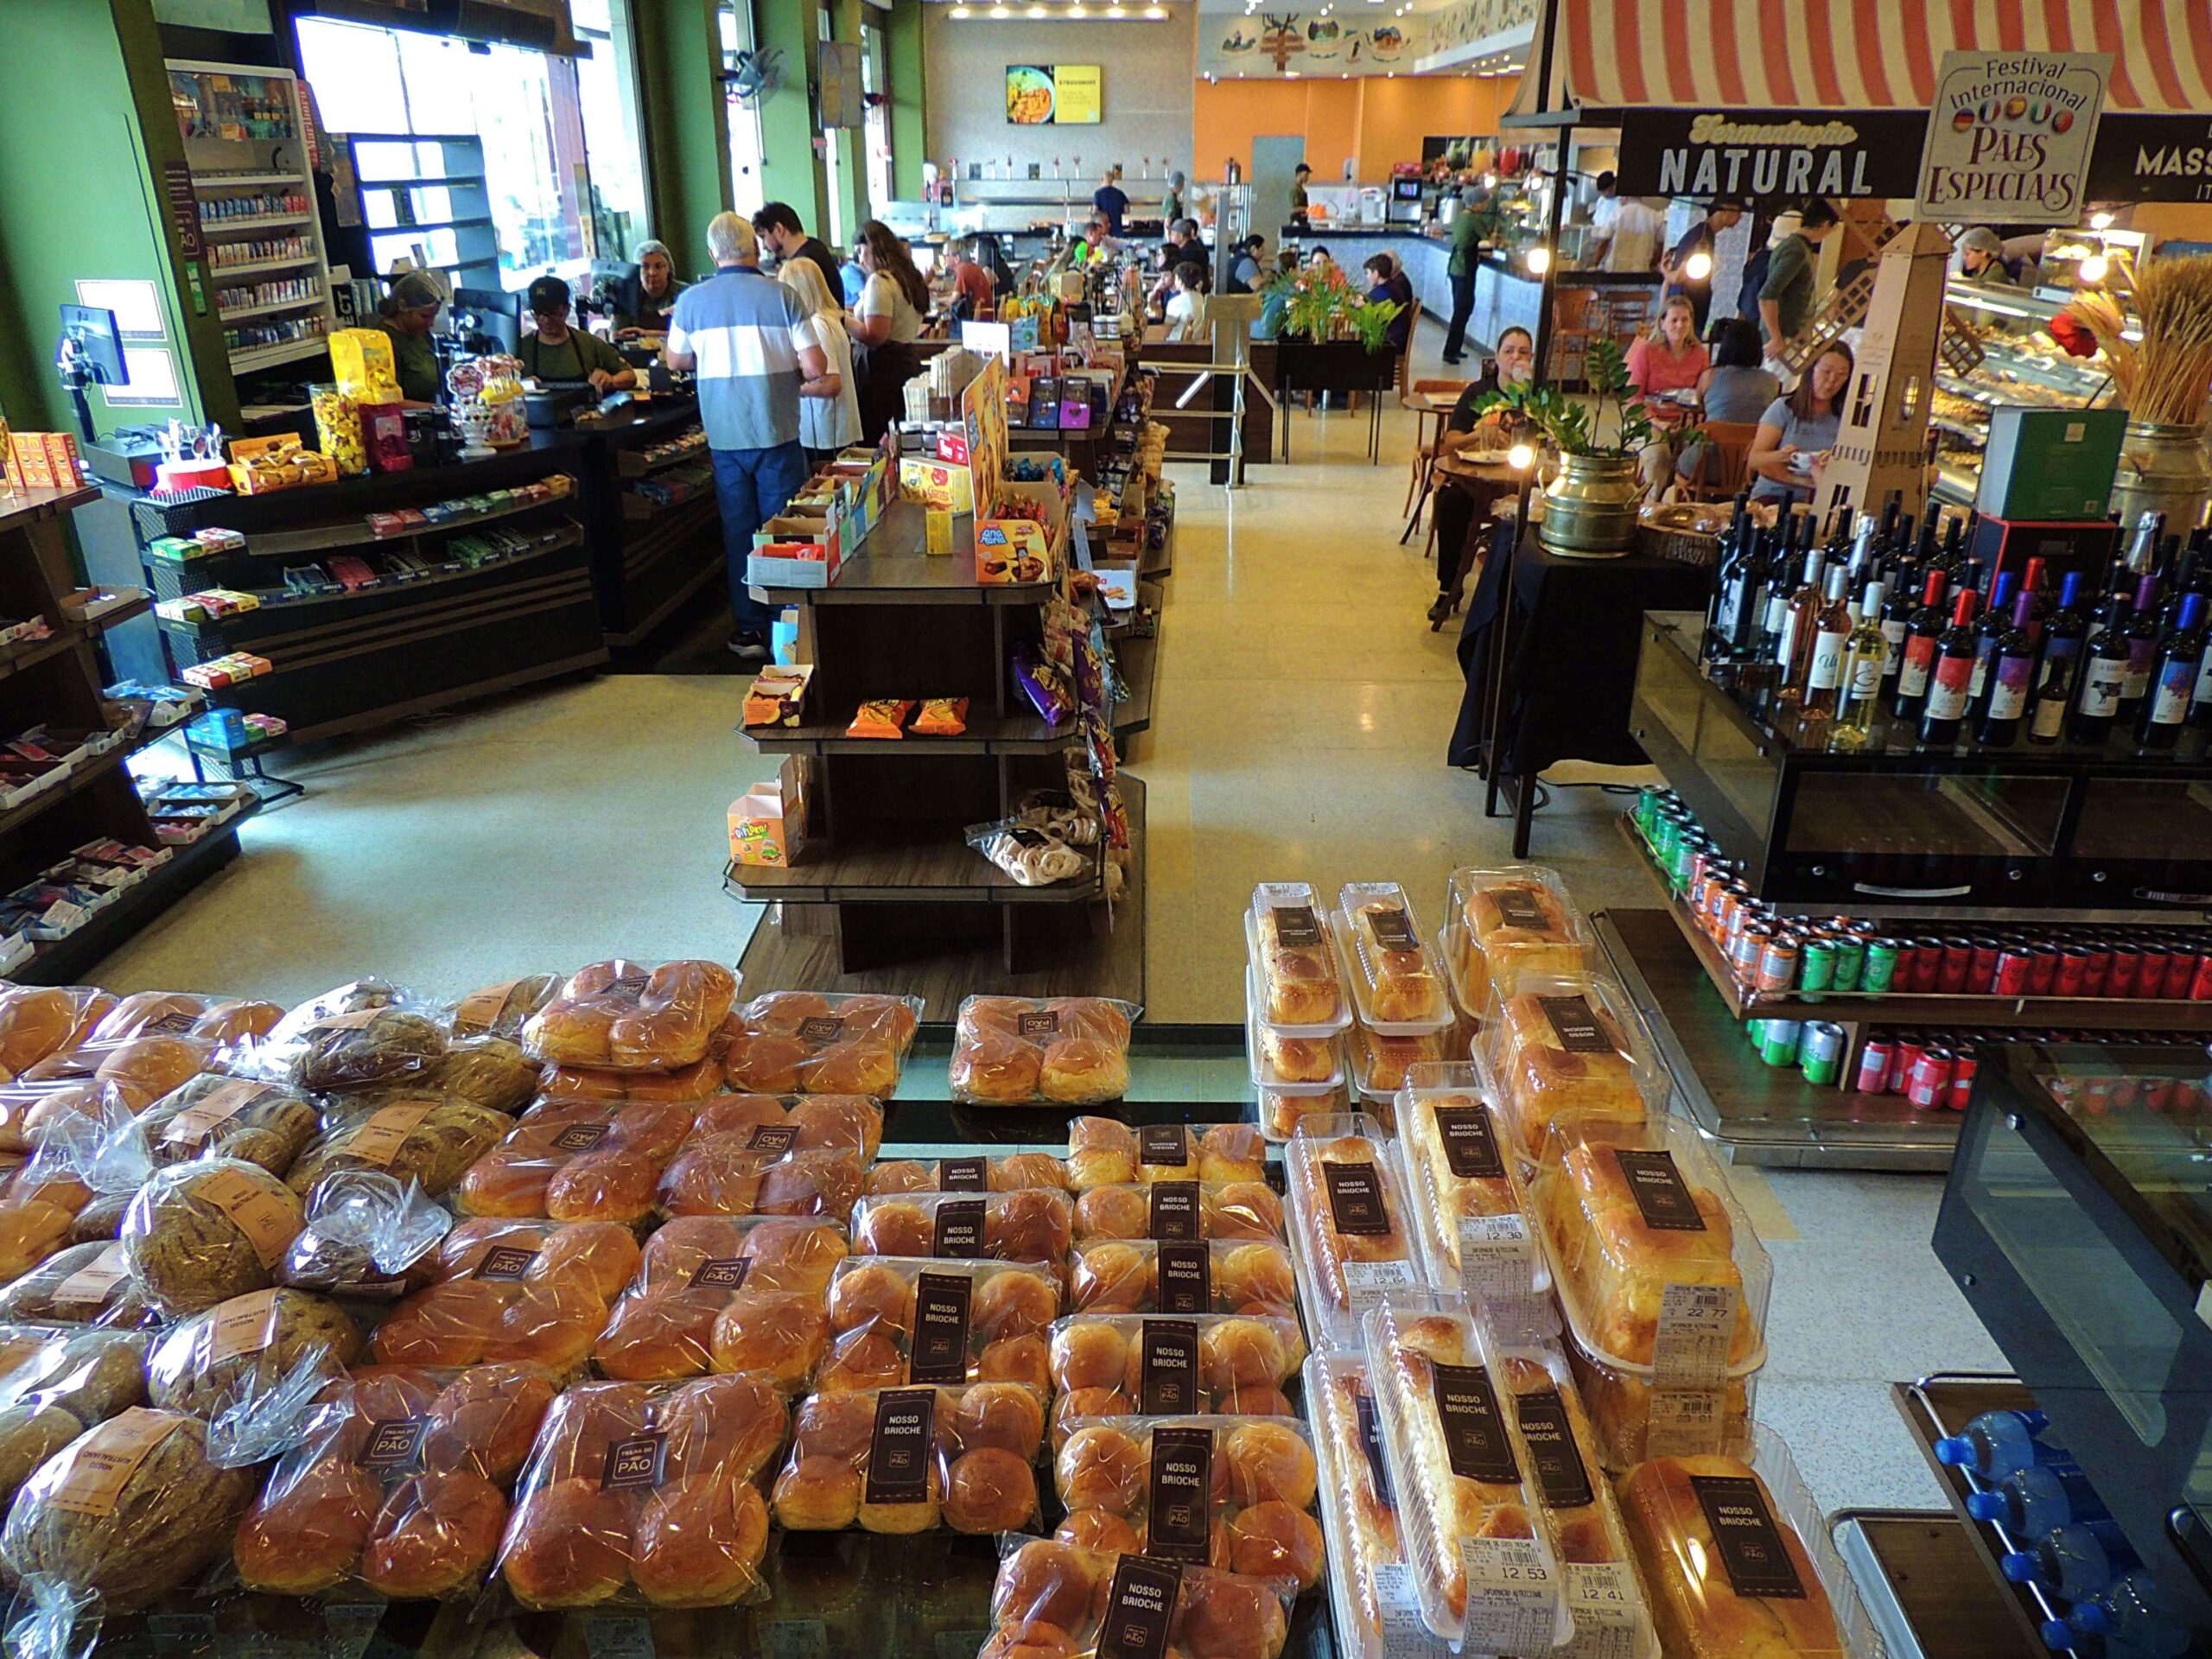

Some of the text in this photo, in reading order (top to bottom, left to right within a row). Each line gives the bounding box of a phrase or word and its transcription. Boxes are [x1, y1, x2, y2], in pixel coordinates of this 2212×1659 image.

[1986, 57, 2067, 79] Festival
[1950, 79, 2088, 111] Internacional
[1688, 113, 1858, 149] Fermentação
[1967, 126, 2048, 172] PÃES
[1658, 149, 1872, 194] NATURAL
[1926, 166, 2076, 212] ESPECIAIS
[1637, 1176, 1675, 1185] BRIOCHE
[1486, 1231, 1522, 1241] 12.30
[1167, 1270, 1201, 1279] BRIOCHE
[930, 1303, 957, 1313] NOSSO
[925, 1313, 959, 1324] BRIOCHE
[1156, 1347, 1185, 1357] NOSSO
[1152, 1358, 1188, 1368] BRIOCHE
[1446, 1394, 1480, 1404] NOSSO
[1446, 1404, 1488, 1415] BRIOCHE
[889, 1415, 918, 1424] NOSSO
[1522, 1422, 1554, 1431] NOSSO
[1166, 1463, 1197, 1473] NOSSO
[1161, 1475, 1200, 1486] BRIOCHE
[1718, 1506, 1753, 1515] NOSSO
[1719, 1516, 1763, 1527] BRIOCHE
[1503, 1567, 1547, 1580] 12.53
[1128, 1582, 1161, 1598] NOSSO
[1582, 1589, 1624, 1600] 12.41
[1122, 1595, 1163, 1611] BRIOCHE
